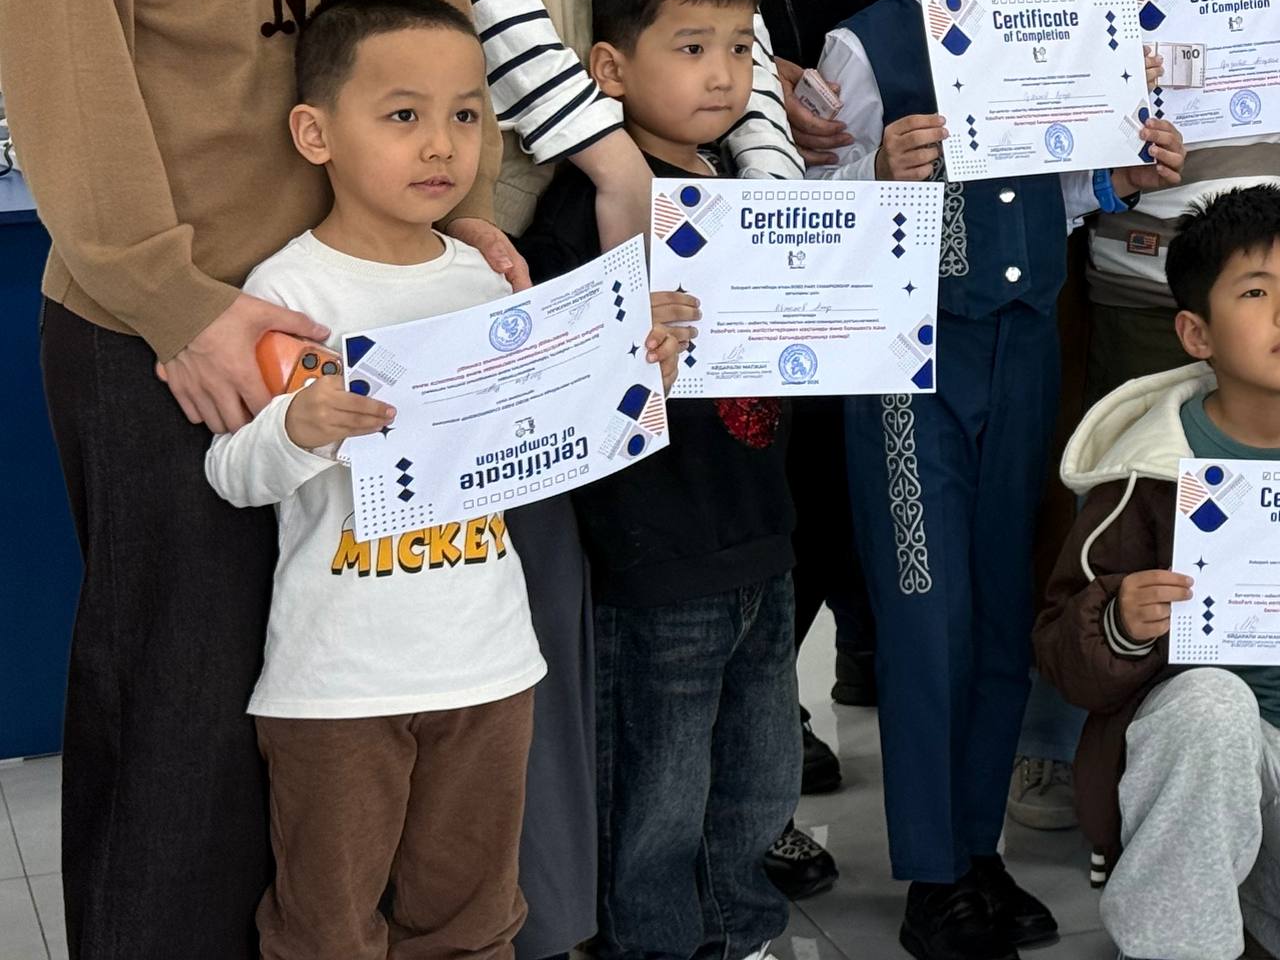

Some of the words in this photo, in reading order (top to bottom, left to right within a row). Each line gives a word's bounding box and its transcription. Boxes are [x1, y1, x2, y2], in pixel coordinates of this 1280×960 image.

[992, 8, 1080, 30] Certificate
[1199, 4, 1210, 15] of
[1003, 30, 1014, 43] of
[1015, 29, 1071, 44] Completion
[740, 207, 856, 230] Certificate
[752, 230, 765, 245] of
[768, 230, 842, 247] Completion
[562, 426, 575, 443] of
[476, 433, 558, 466] Completion
[459, 436, 589, 490] Certificate
[331, 511, 507, 577] MICKEY
